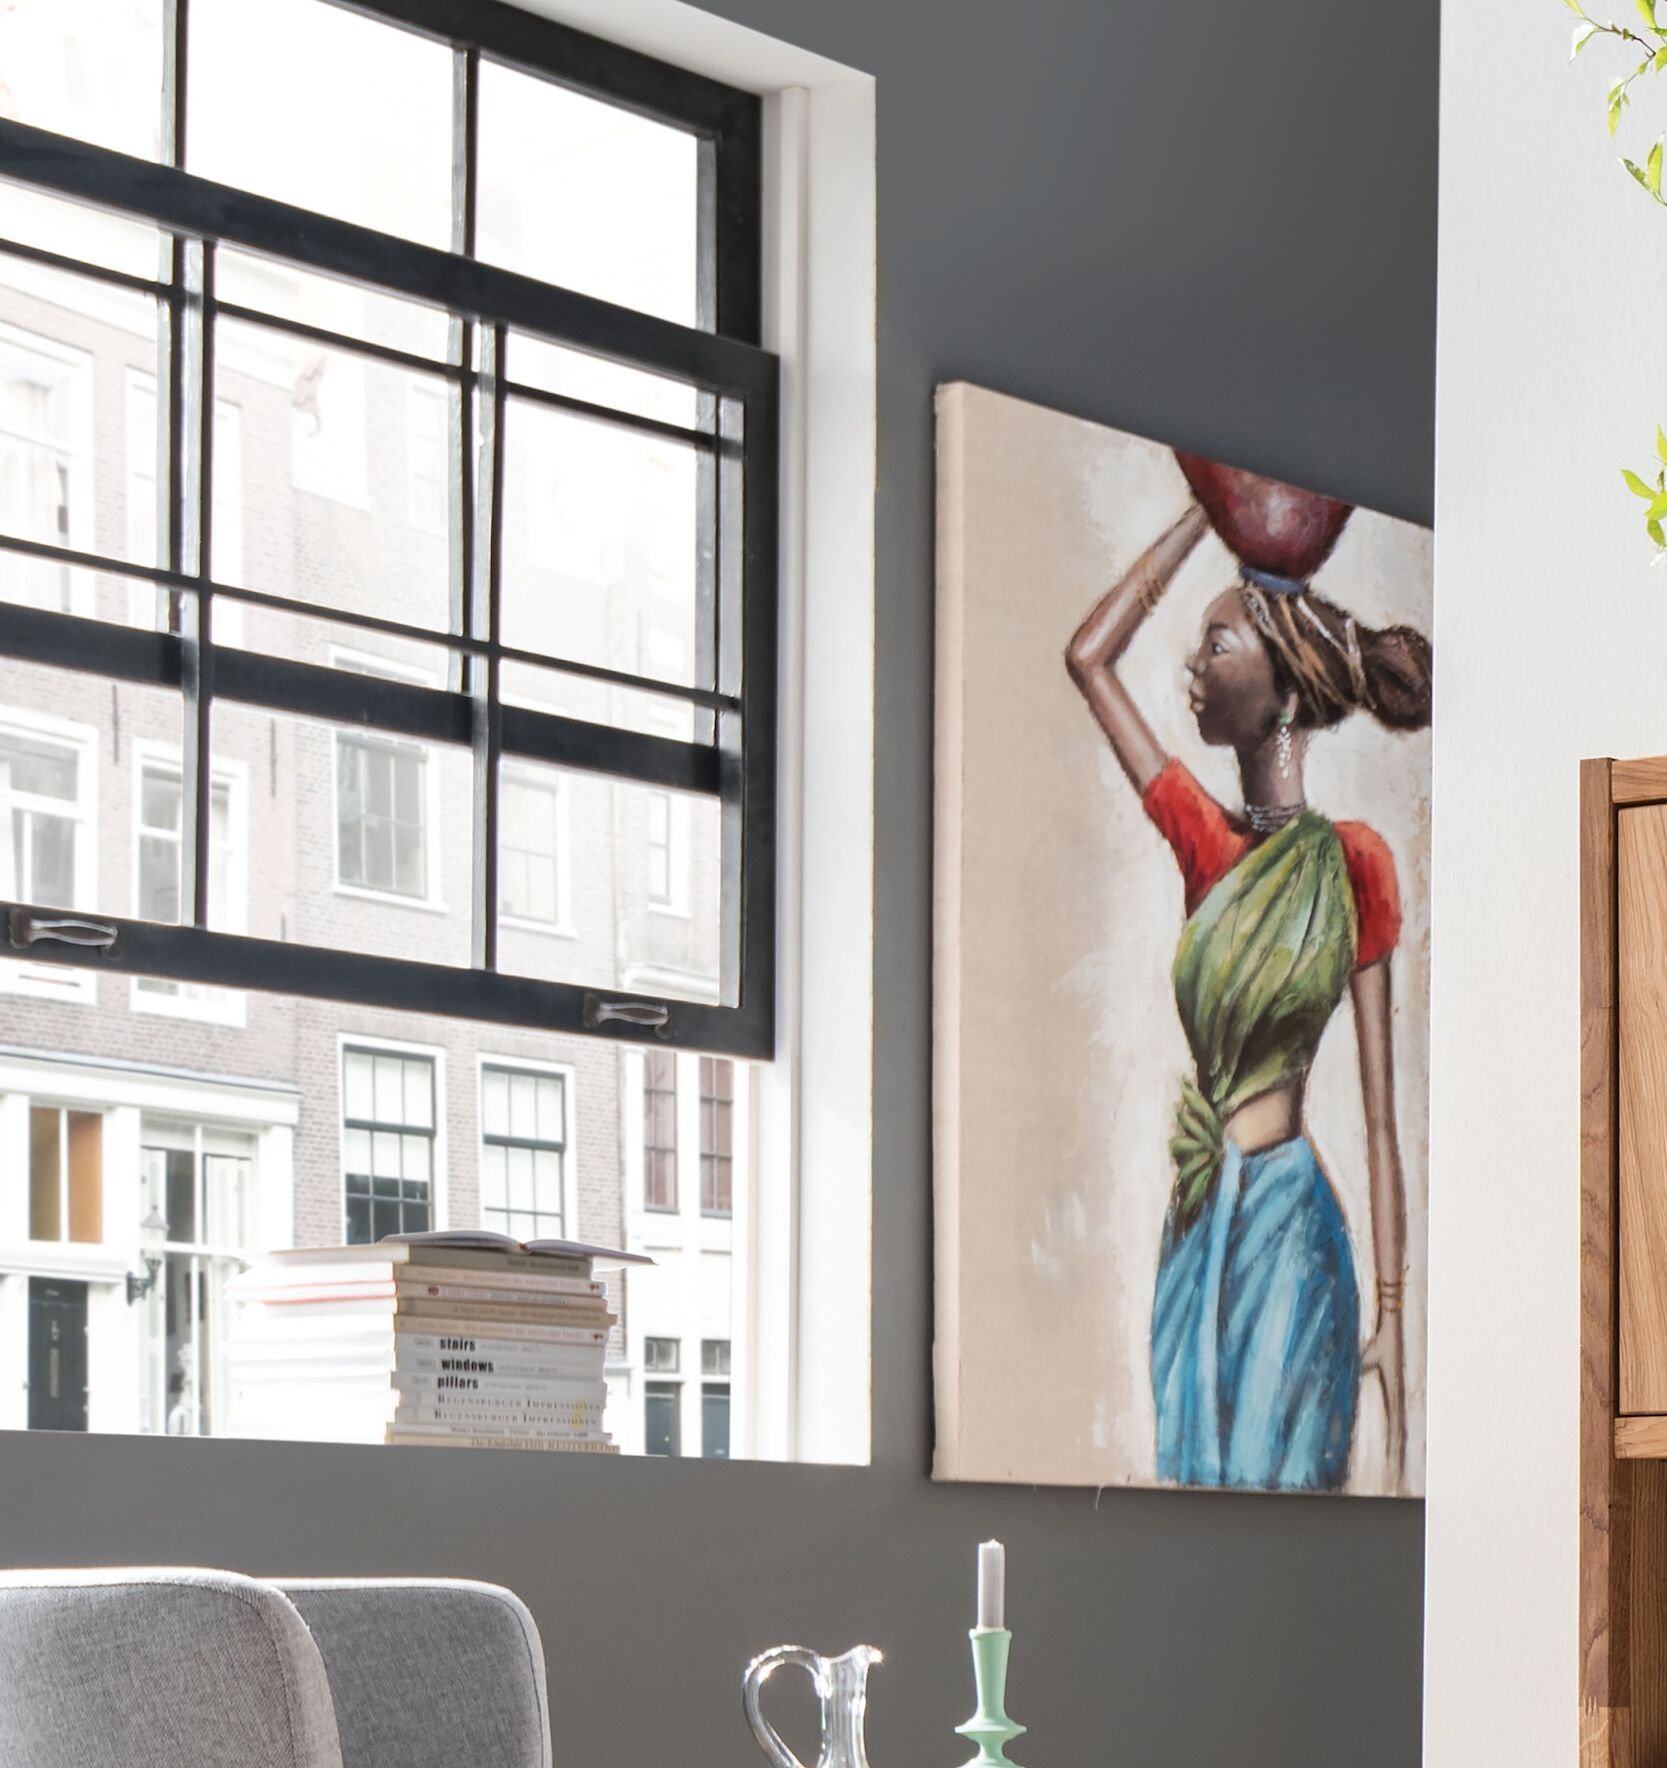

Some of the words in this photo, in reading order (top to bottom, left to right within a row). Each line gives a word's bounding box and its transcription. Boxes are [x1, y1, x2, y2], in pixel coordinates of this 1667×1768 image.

[440, 1337, 476, 1352] stairs
[441, 1358, 494, 1372] windows
[437, 1376, 478, 1390] pillars
